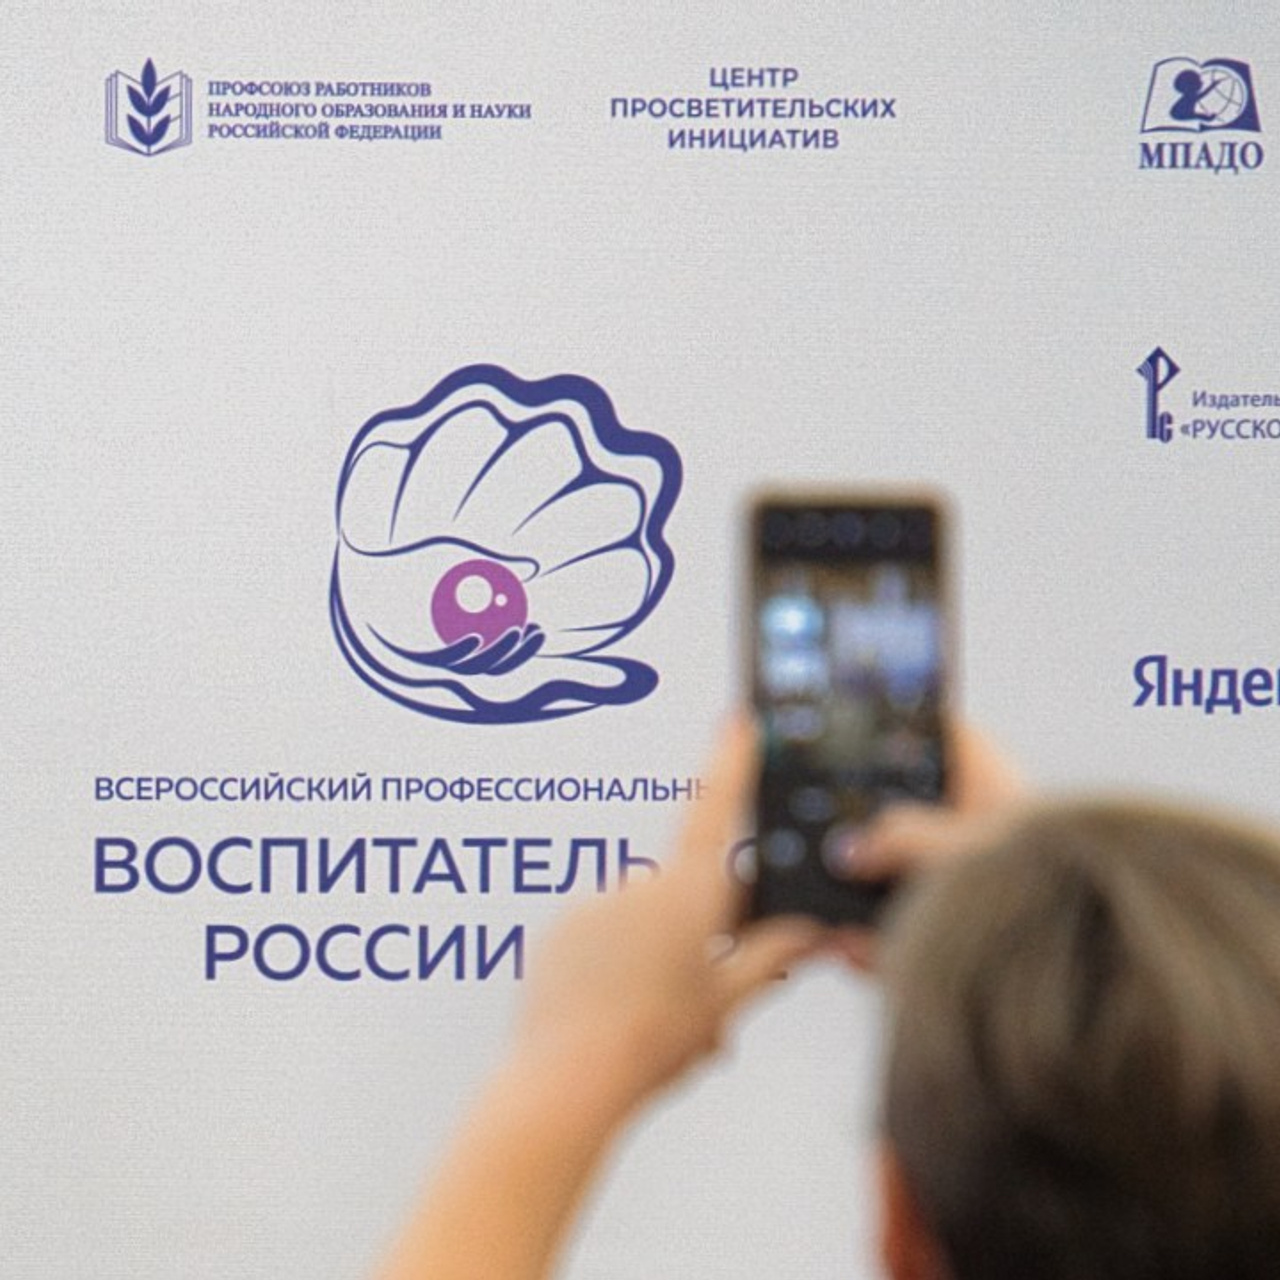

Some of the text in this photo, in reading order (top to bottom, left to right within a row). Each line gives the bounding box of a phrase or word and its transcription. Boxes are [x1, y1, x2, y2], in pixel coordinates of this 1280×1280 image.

[207, 80, 432, 98] ПРОФСОЮЗ РАБОТНИКОВ
[709, 67, 799, 92] ЦЕНТР
[207, 101, 532, 120] НАРОДНОГО ОБРАЗОВАНИЯ И НАУКИ
[610, 97, 897, 119] ПРОСВЕТИТЕЛЬСКИХ
[207, 120, 443, 142] РОССИЙСКОЙ ФЕДЕРАЦИИ
[667, 128, 840, 153] ИНИЦИАТИВ
[1138, 141, 1265, 175] МПАДО
[1133, 654, 1280, 716] Янде
[94, 771, 372, 803] ВСЕРОССИЙСКИЙ
[205, 923, 525, 982] РОССИИ
